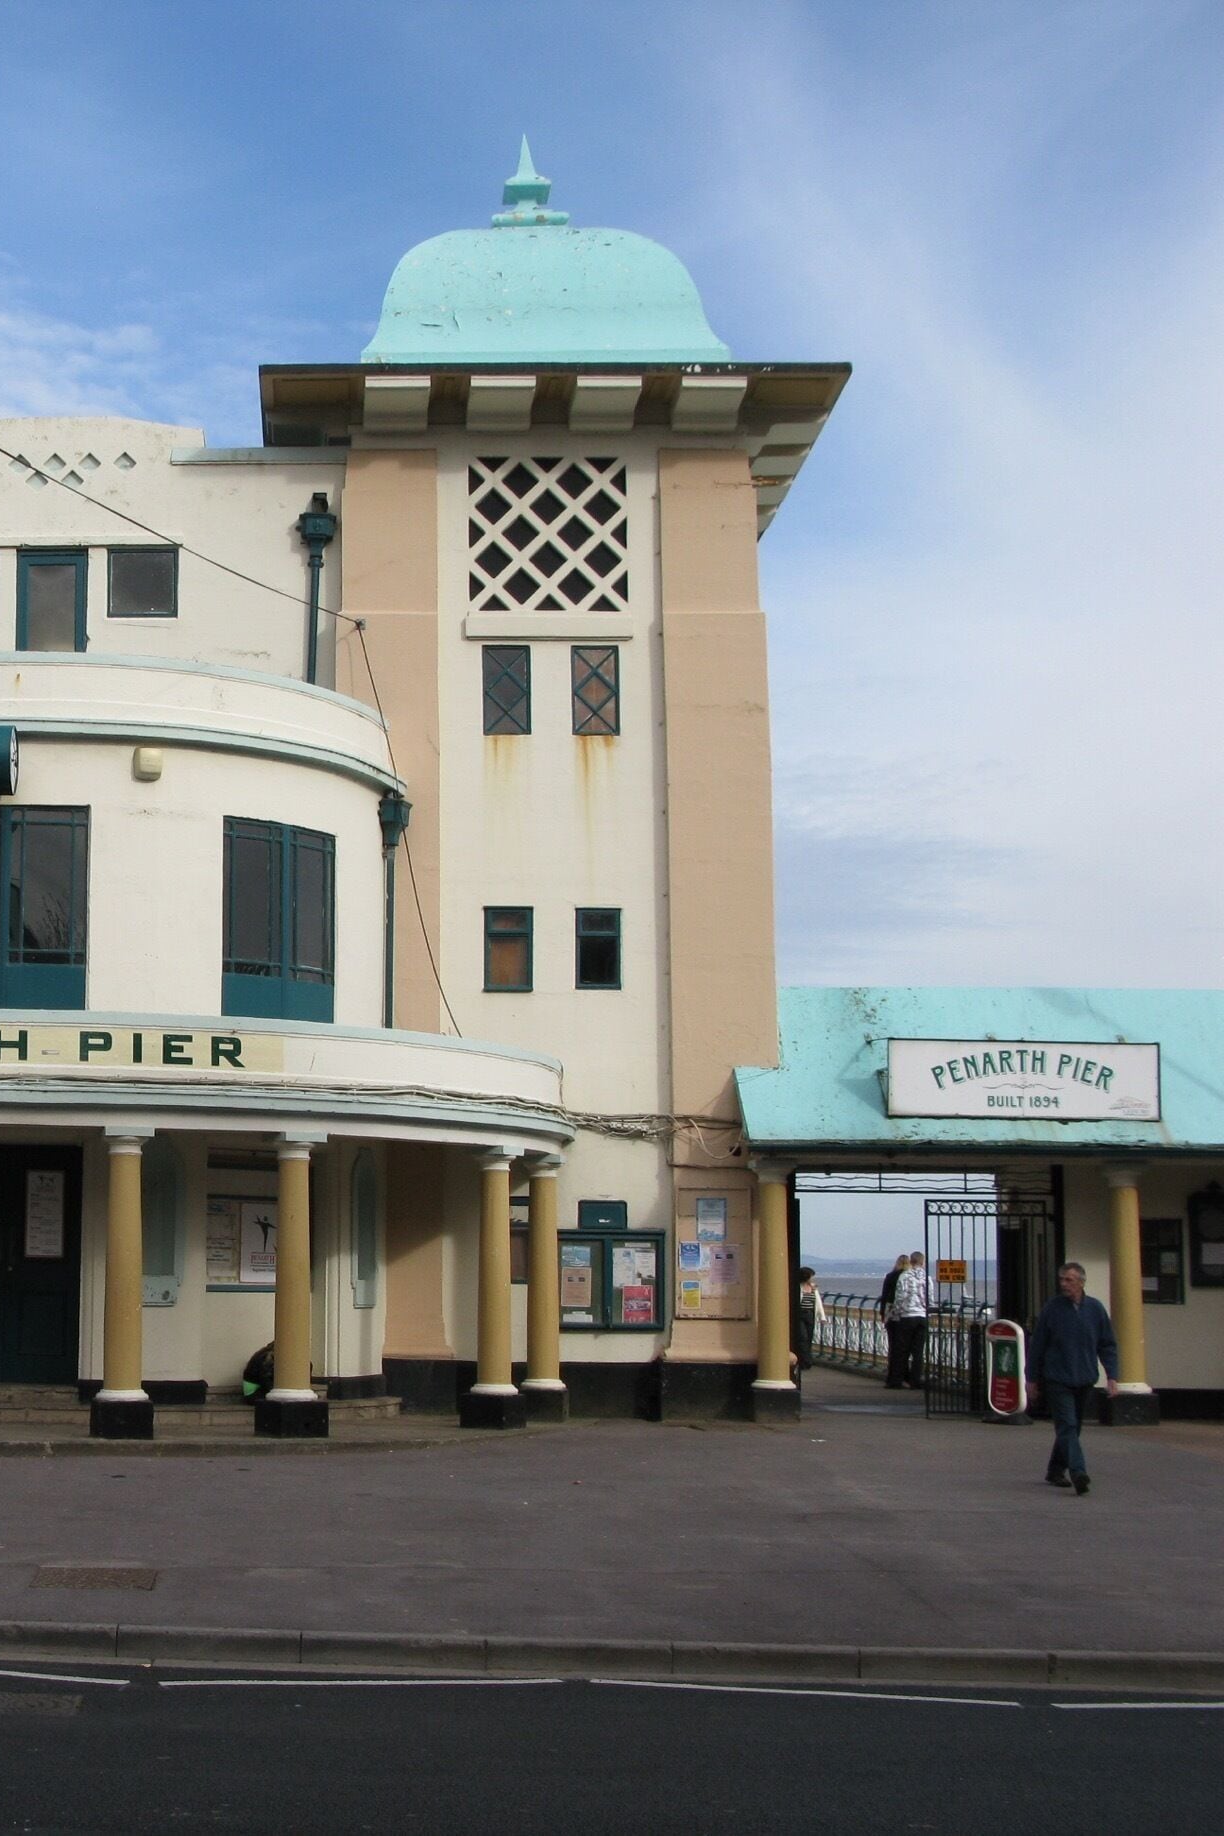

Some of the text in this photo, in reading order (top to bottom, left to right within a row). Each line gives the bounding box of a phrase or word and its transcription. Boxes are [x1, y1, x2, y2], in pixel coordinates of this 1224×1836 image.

[78, 1031, 246, 1068] PIER
[930, 1049, 1115, 1094] PENARTH PIER
[986, 1095, 1060, 1109] BUILT 1894
